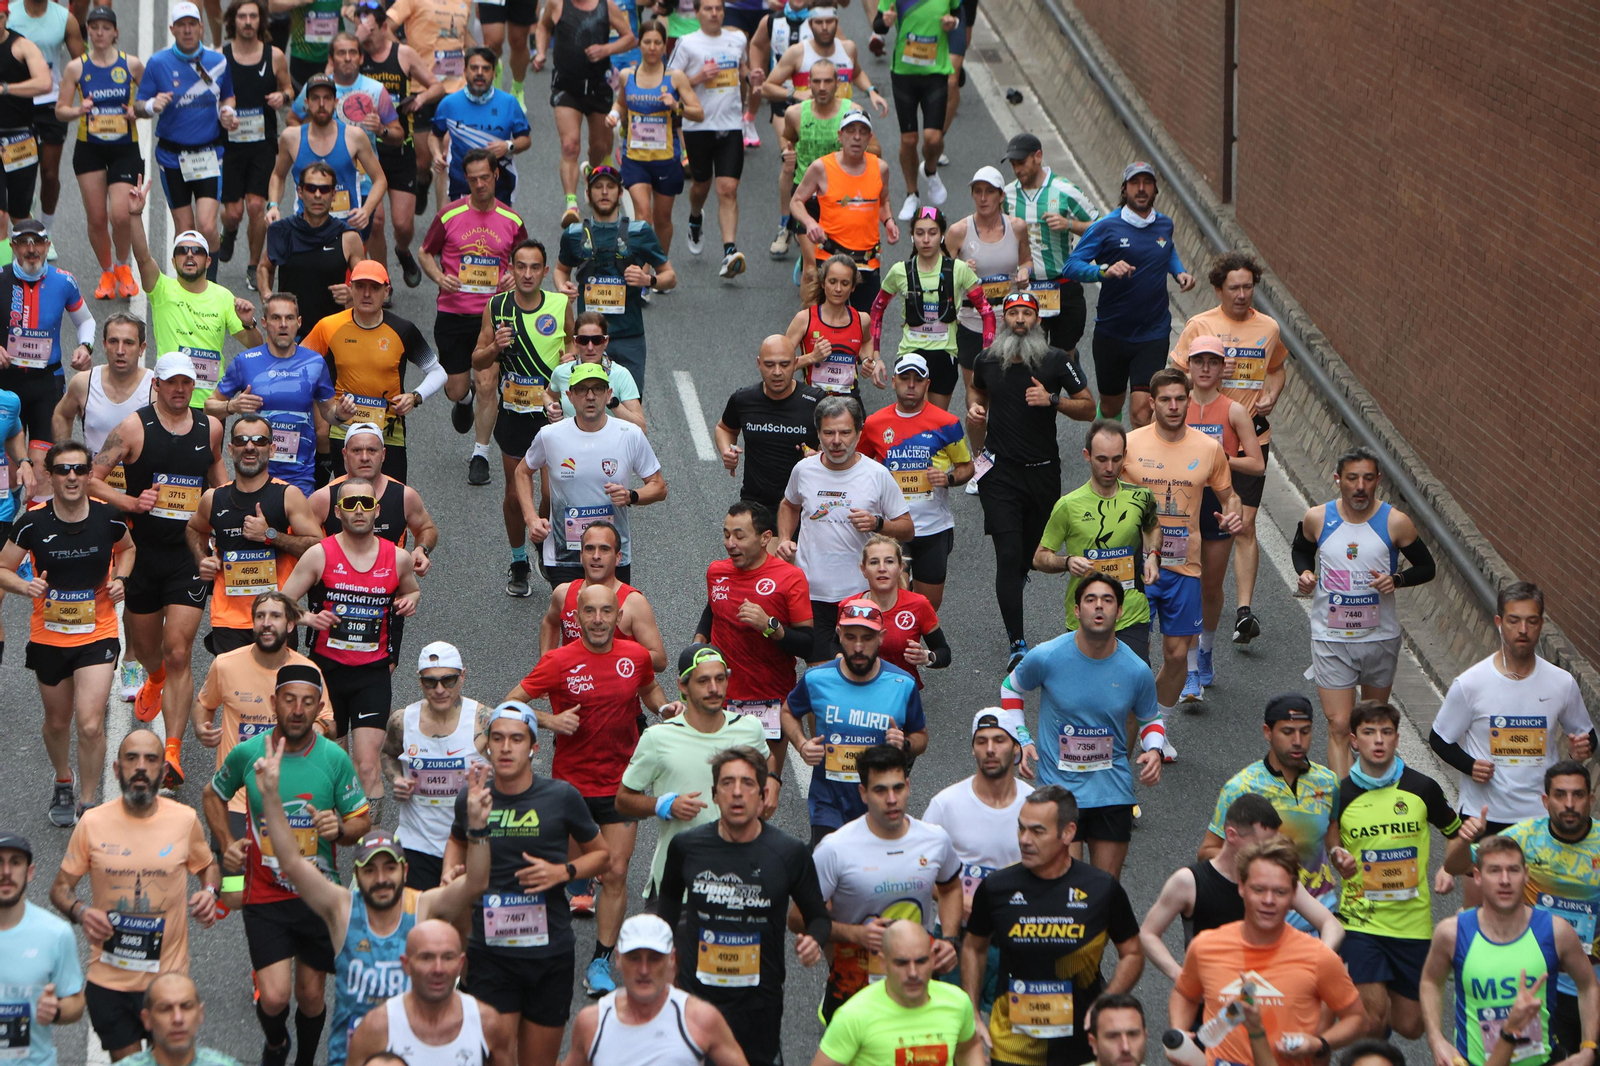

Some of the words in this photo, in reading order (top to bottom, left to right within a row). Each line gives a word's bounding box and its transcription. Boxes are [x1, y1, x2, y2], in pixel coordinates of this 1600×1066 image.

[365, 72, 401, 82] horlton
[88, 88, 127, 99] LONDON
[101, 106, 123, 115] ZURICH
[11, 133, 32, 144] ZURICH
[461, 226, 502, 244] GUADIAMAR
[473, 257, 496, 266] ZURICH
[473, 269, 487, 277] 4326
[598, 276, 622, 284] ZURICH
[597, 289, 611, 297] 5814
[24, 329, 49, 338] ZURICH
[18, 352, 41, 360] PATILLAS
[193, 350, 217, 359] ZURICH
[245, 351, 262, 359] HOKA
[1239, 349, 1262, 357] ZURICH
[829, 354, 853, 363] ZURICH
[828, 367, 842, 375] 7831
[1237, 362, 1252, 370] 6241
[356, 397, 382, 406] ZURICH
[271, 421, 297, 431] ZURICH
[746, 421, 807, 435] Run4Schools
[273, 435, 285, 443] 683
[886, 449, 930, 460] PALACIEGO
[902, 462, 928, 470] ZURICH
[170, 476, 198, 486] ZURICH
[901, 475, 918, 484] 6149
[1142, 476, 1168, 486] Maratón
[168, 491, 186, 500] 3715
[168, 503, 185, 511] MARK
[581, 506, 608, 517] ZURICH
[49, 546, 99, 558] TRIALS
[240, 551, 270, 561] ZURICH
[1101, 548, 1128, 558] ZURICH
[240, 566, 259, 575] 4692
[1101, 563, 1118, 572] 5403
[251, 577, 270, 585] CORAL
[335, 582, 369, 593] atletismo
[371, 585, 386, 594] club
[60, 591, 90, 600] ZURICH
[326, 590, 391, 605] MANCHATHON
[1345, 595, 1373, 605] ZURICH
[59, 607, 78, 616] 5802
[350, 606, 379, 616] ZURICH
[1344, 610, 1362, 619] 7440
[347, 622, 366, 632] 3106
[348, 634, 363, 642] DANI
[566, 674, 593, 685] REGALA
[240, 712, 268, 722] Maratón
[826, 704, 843, 724] EL
[848, 709, 890, 731] MURO
[1510, 718, 1541, 727] ZURICH
[1077, 726, 1108, 736] ZURICH
[845, 735, 876, 744] ZURICH
[1509, 734, 1529, 743] 4866
[1077, 742, 1096, 751] 7356
[1494, 747, 1521, 756] ANTONIO
[1063, 754, 1081, 762] MODO
[426, 759, 458, 769] ZURICH
[427, 775, 446, 785] 6412
[419, 787, 458, 796] VALLECILLOS
[486, 808, 540, 828] FILA
[1350, 820, 1421, 839] CASTRIEL
[1380, 849, 1412, 860] ZURICH
[1382, 868, 1402, 877] 3895
[692, 881, 735, 896] ZUBIRI
[874, 878, 924, 895] olimpia
[1382, 881, 1405, 890] ROBER
[505, 895, 538, 905] ZURICH
[706, 894, 772, 908] PAMPLONA
[1557, 900, 1592, 913] ZURICH
[505, 913, 526, 923] 7467
[1019, 916, 1037, 925] CLUB
[1037, 916, 1074, 925] DEPORTIVO
[123, 919, 159, 931] ZURICH
[495, 928, 519, 936] ANDRE
[521, 926, 539, 935] MELO
[1008, 923, 1085, 939] ARUNCI
[718, 935, 753, 945] ZURICH
[717, 953, 739, 963] 4920
[716, 966, 740, 975] MANDI
[1029, 983, 1065, 993] ZURICH
[1259, 997, 1284, 1006] RAIL
[0, 1005, 23, 1015] RICH
[1029, 1002, 1051, 1012] 5498
